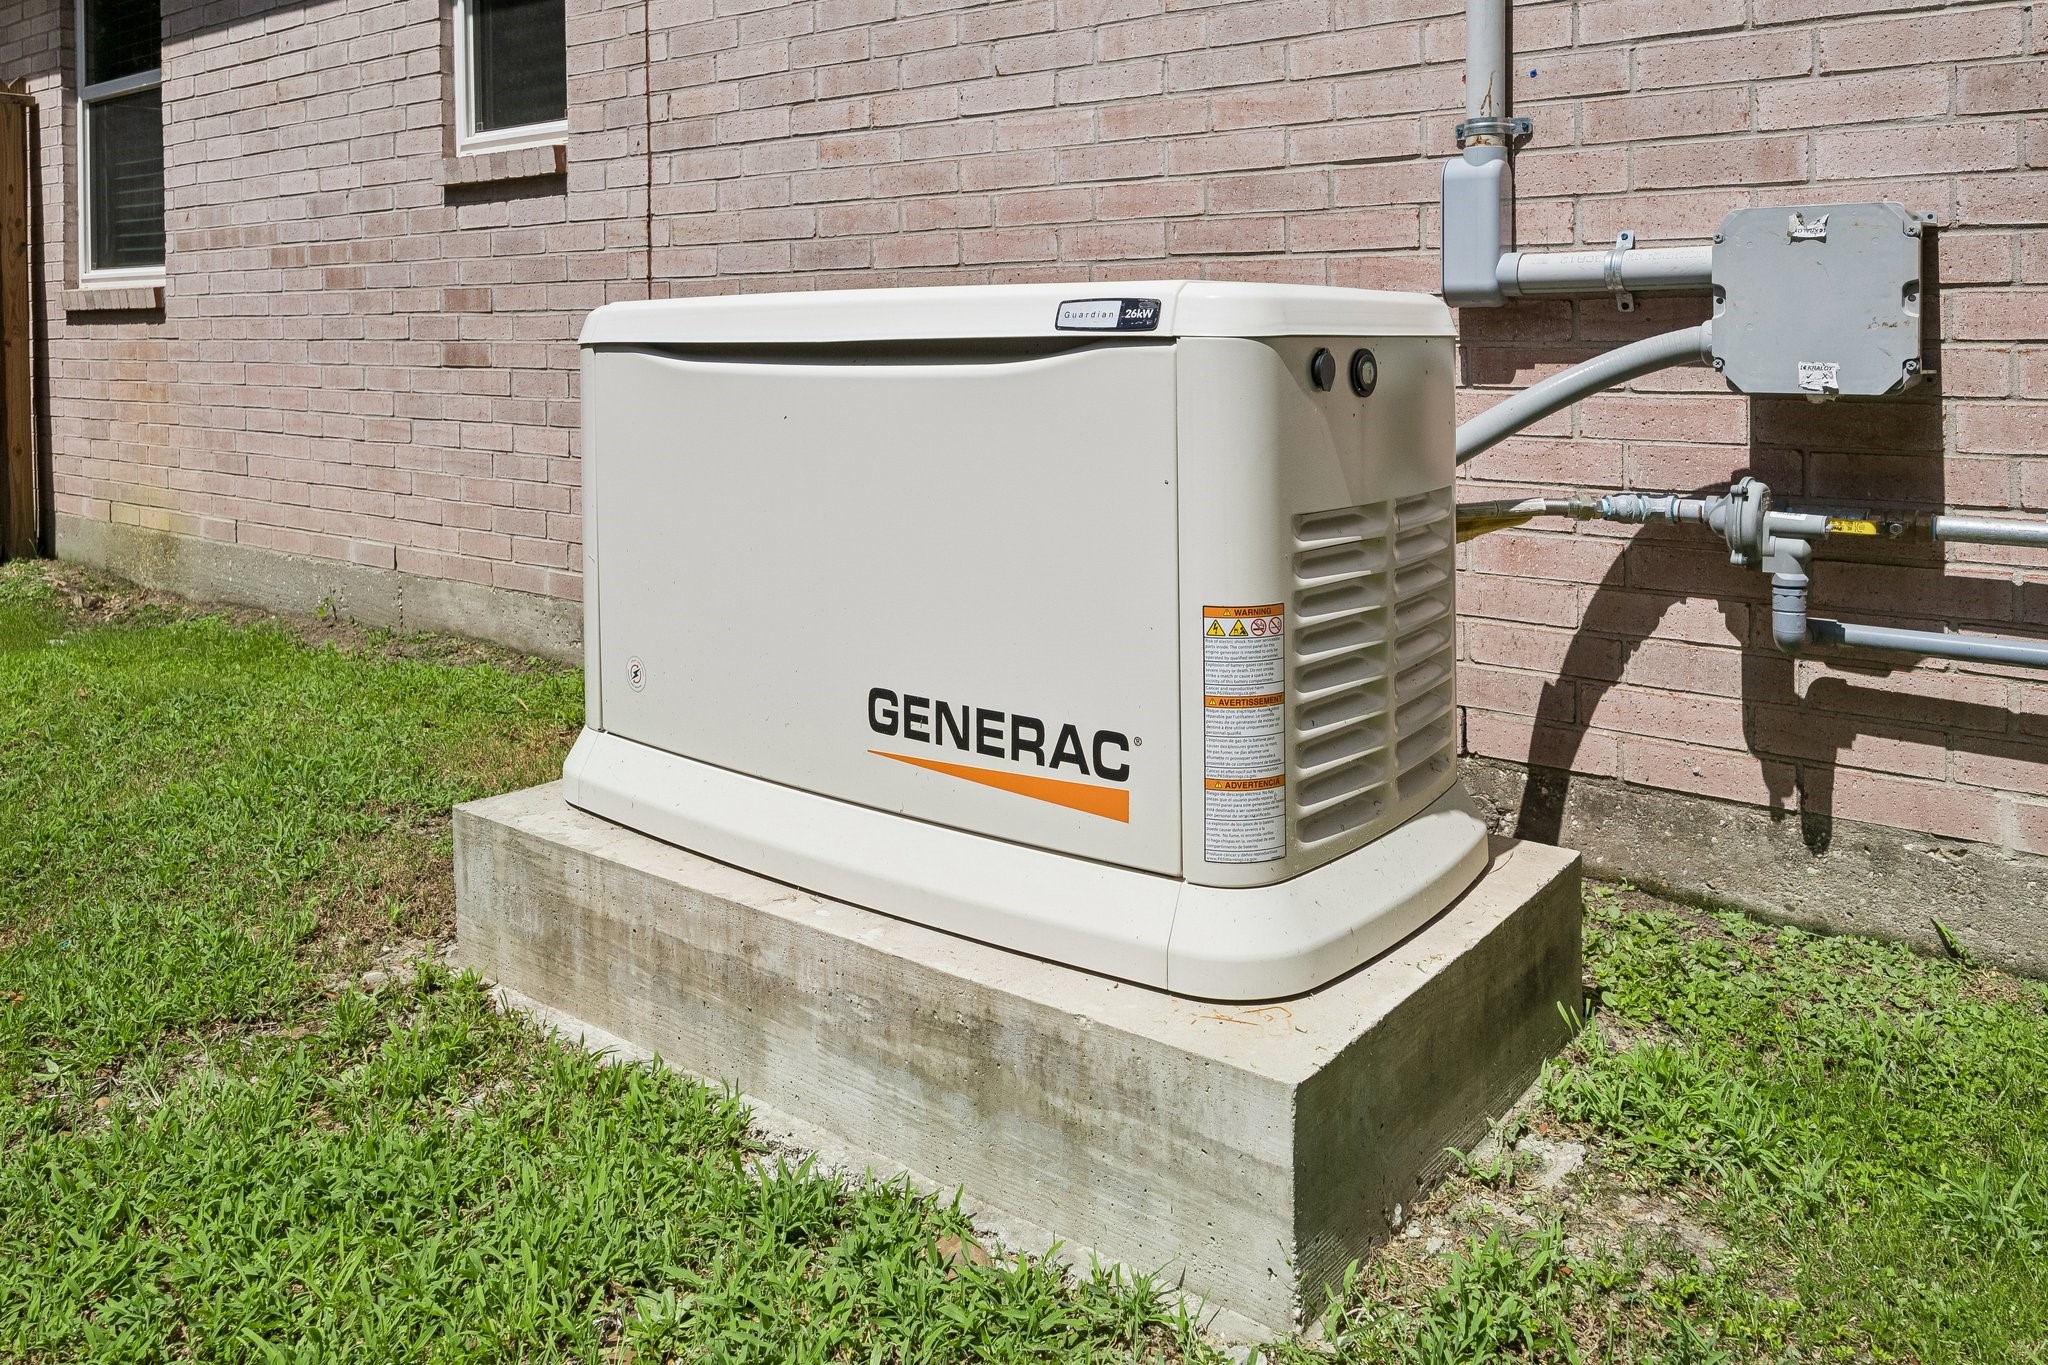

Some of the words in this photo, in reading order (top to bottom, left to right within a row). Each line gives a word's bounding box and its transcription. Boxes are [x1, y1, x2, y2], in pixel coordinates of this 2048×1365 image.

[1064, 310, 1114, 319] Guardian
[1125, 308, 1154, 319] 26kW
[1234, 608, 1272, 616] WARNING
[1218, 696, 1282, 706] AVERTISSEMENT
[1225, 778, 1280, 789] ADVERTENCIA
